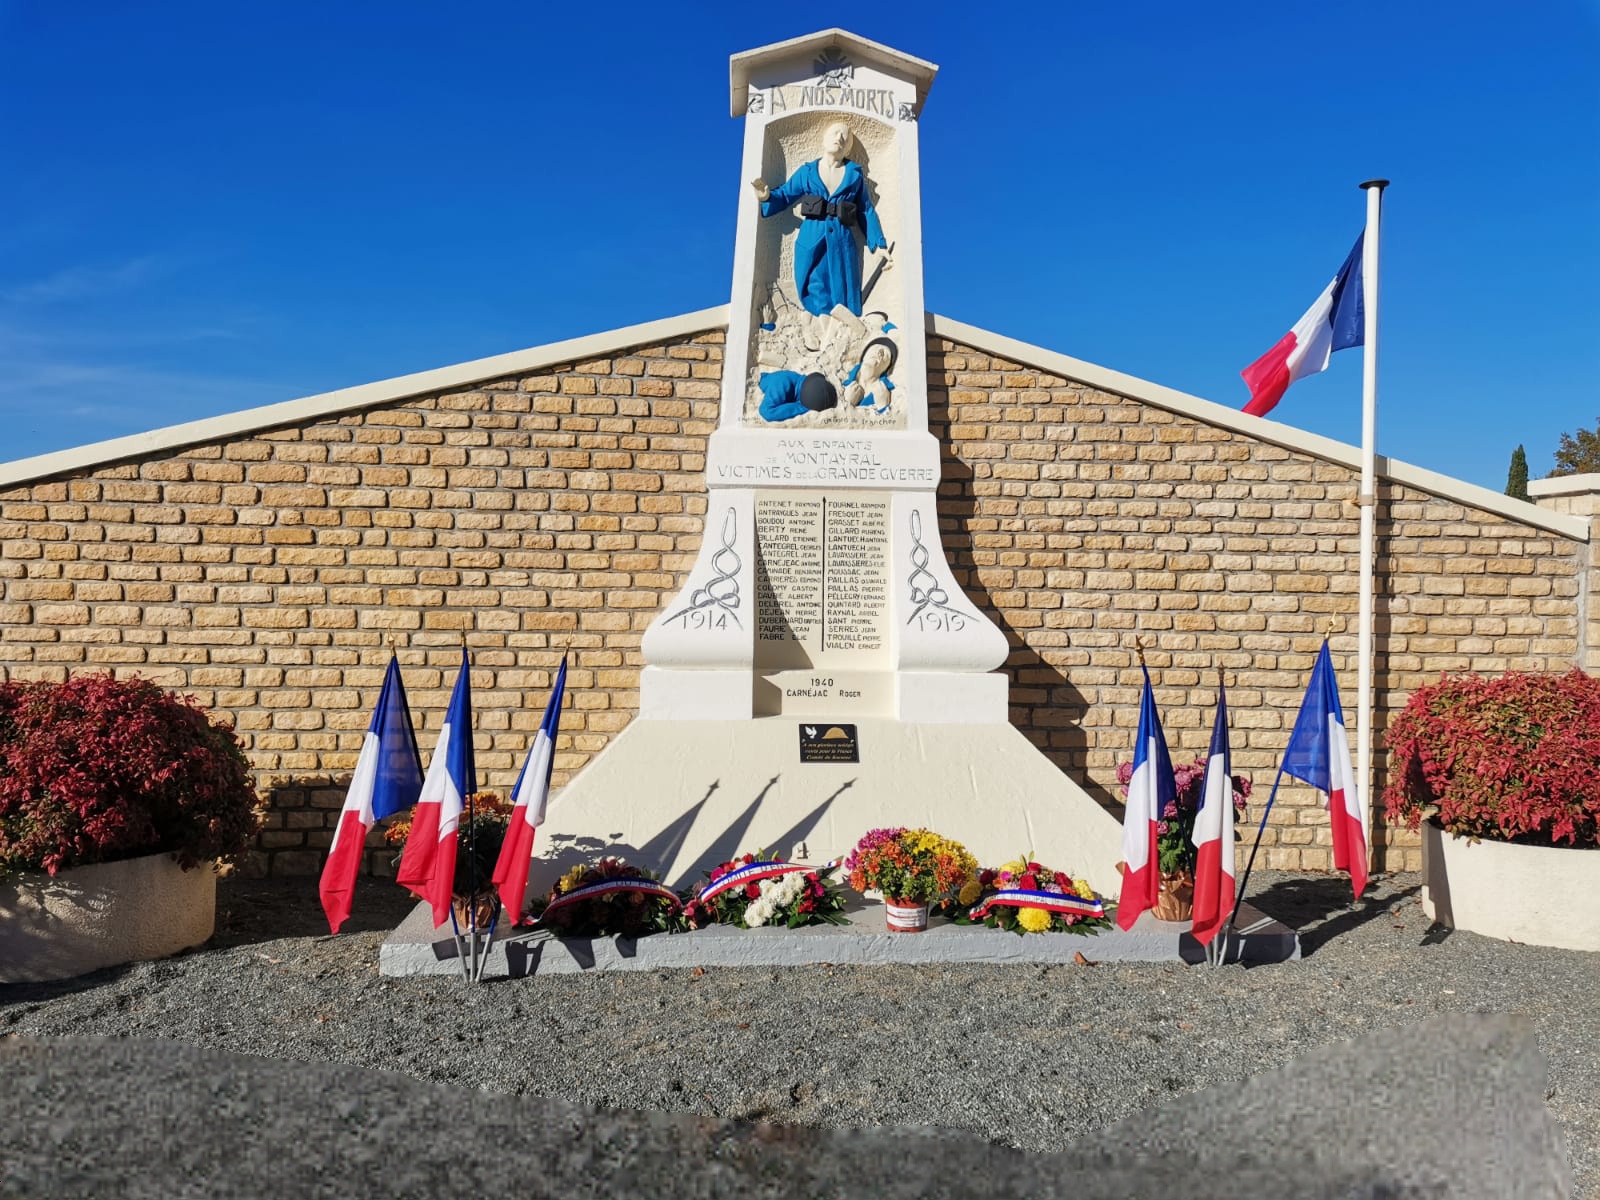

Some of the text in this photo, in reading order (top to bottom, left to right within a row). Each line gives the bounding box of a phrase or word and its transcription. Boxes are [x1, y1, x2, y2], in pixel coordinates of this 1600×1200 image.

[800, 86, 835, 107] NOS
[839, 88, 895, 119] MORTS
[777, 440, 873, 450] AUX ENFANTS
[784, 452, 881, 466] MONTAYRAL
[718, 465, 792, 479] VICTIMES
[817, 467, 876, 480] GRANDE
[828, 501, 860, 509] FOURNEL
[758, 525, 786, 533] BERTY
[828, 527, 860, 535] GILLARD
[757, 542, 800, 550] CANTEGREL
[757, 550, 800, 558] CANTEGREL
[828, 568, 861, 576] MOUSSAC
[827, 576, 860, 585] PAILLAS
[827, 585, 859, 593] PAILLAS
[827, 601, 861, 609] QUINTARD
[759, 608, 791, 616] DEJEAN
[827, 609, 856, 617] RAYNAL
[683, 610, 728, 631] 1914
[827, 617, 847, 625] SANT
[827, 625, 859, 633] SERRES
[759, 633, 785, 641] FABRE
[811, 678, 834, 687] 1940
